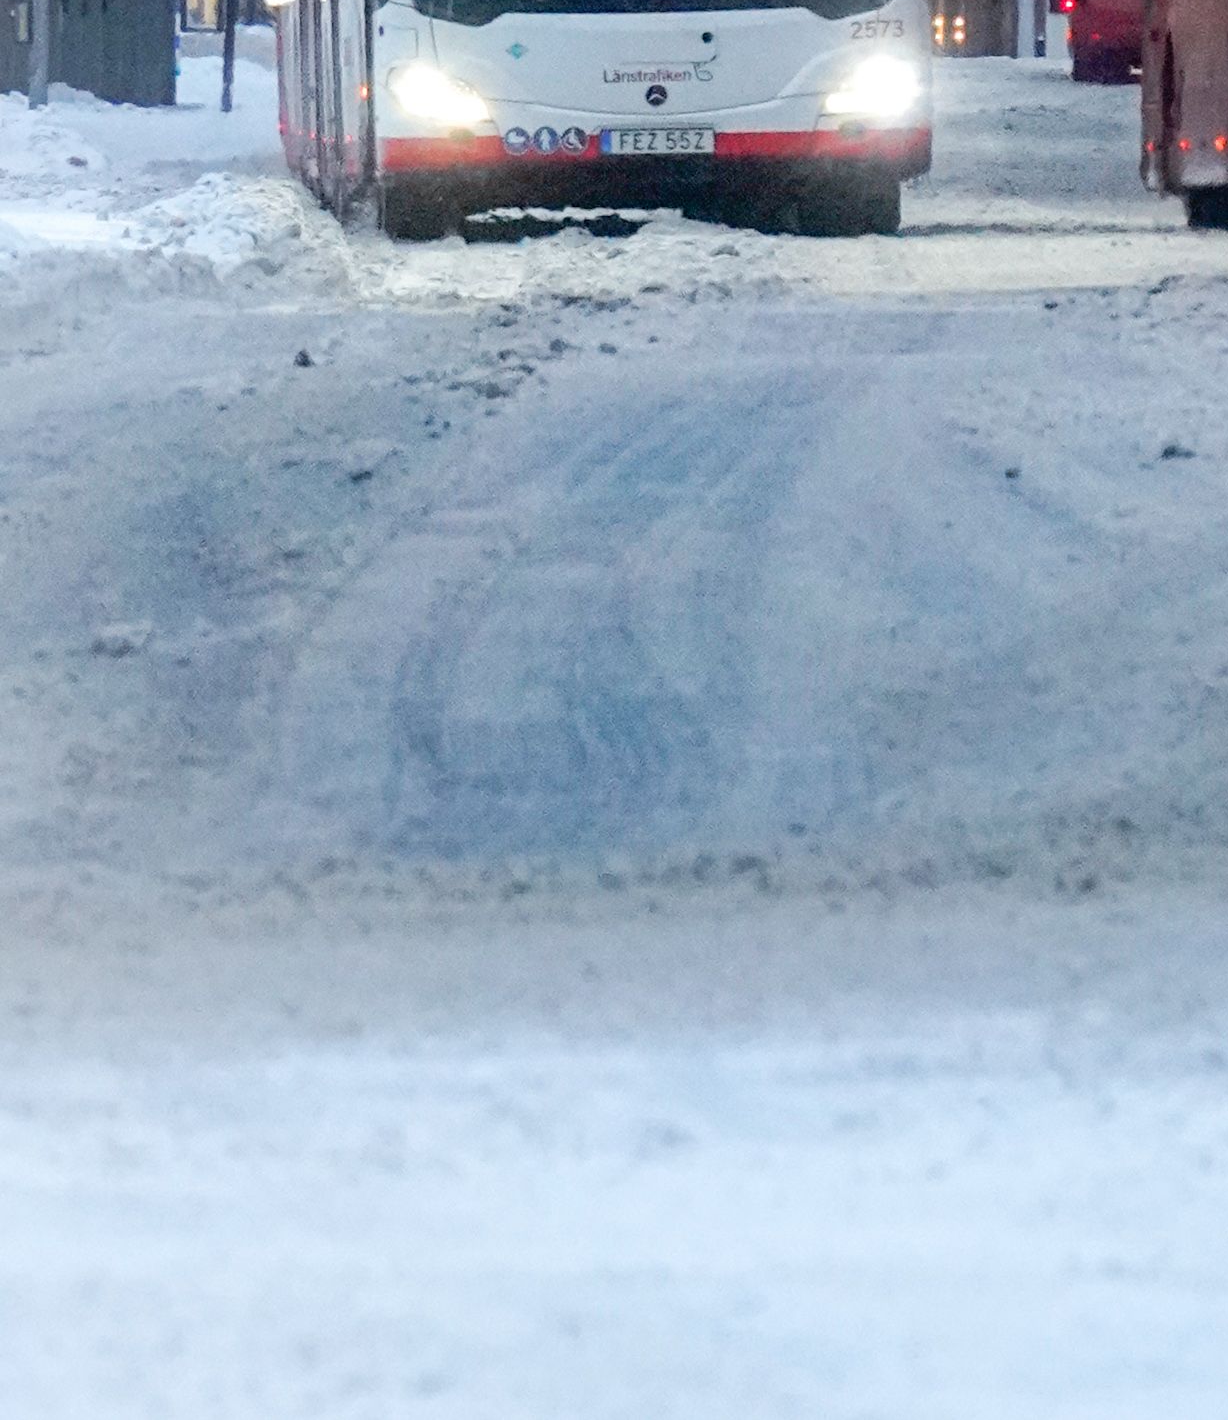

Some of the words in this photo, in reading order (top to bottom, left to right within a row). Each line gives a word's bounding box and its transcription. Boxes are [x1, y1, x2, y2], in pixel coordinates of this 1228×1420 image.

[851, 20, 904, 39] 2573
[603, 69, 692, 83] Länstrafiken
[620, 132, 658, 150] FEZ
